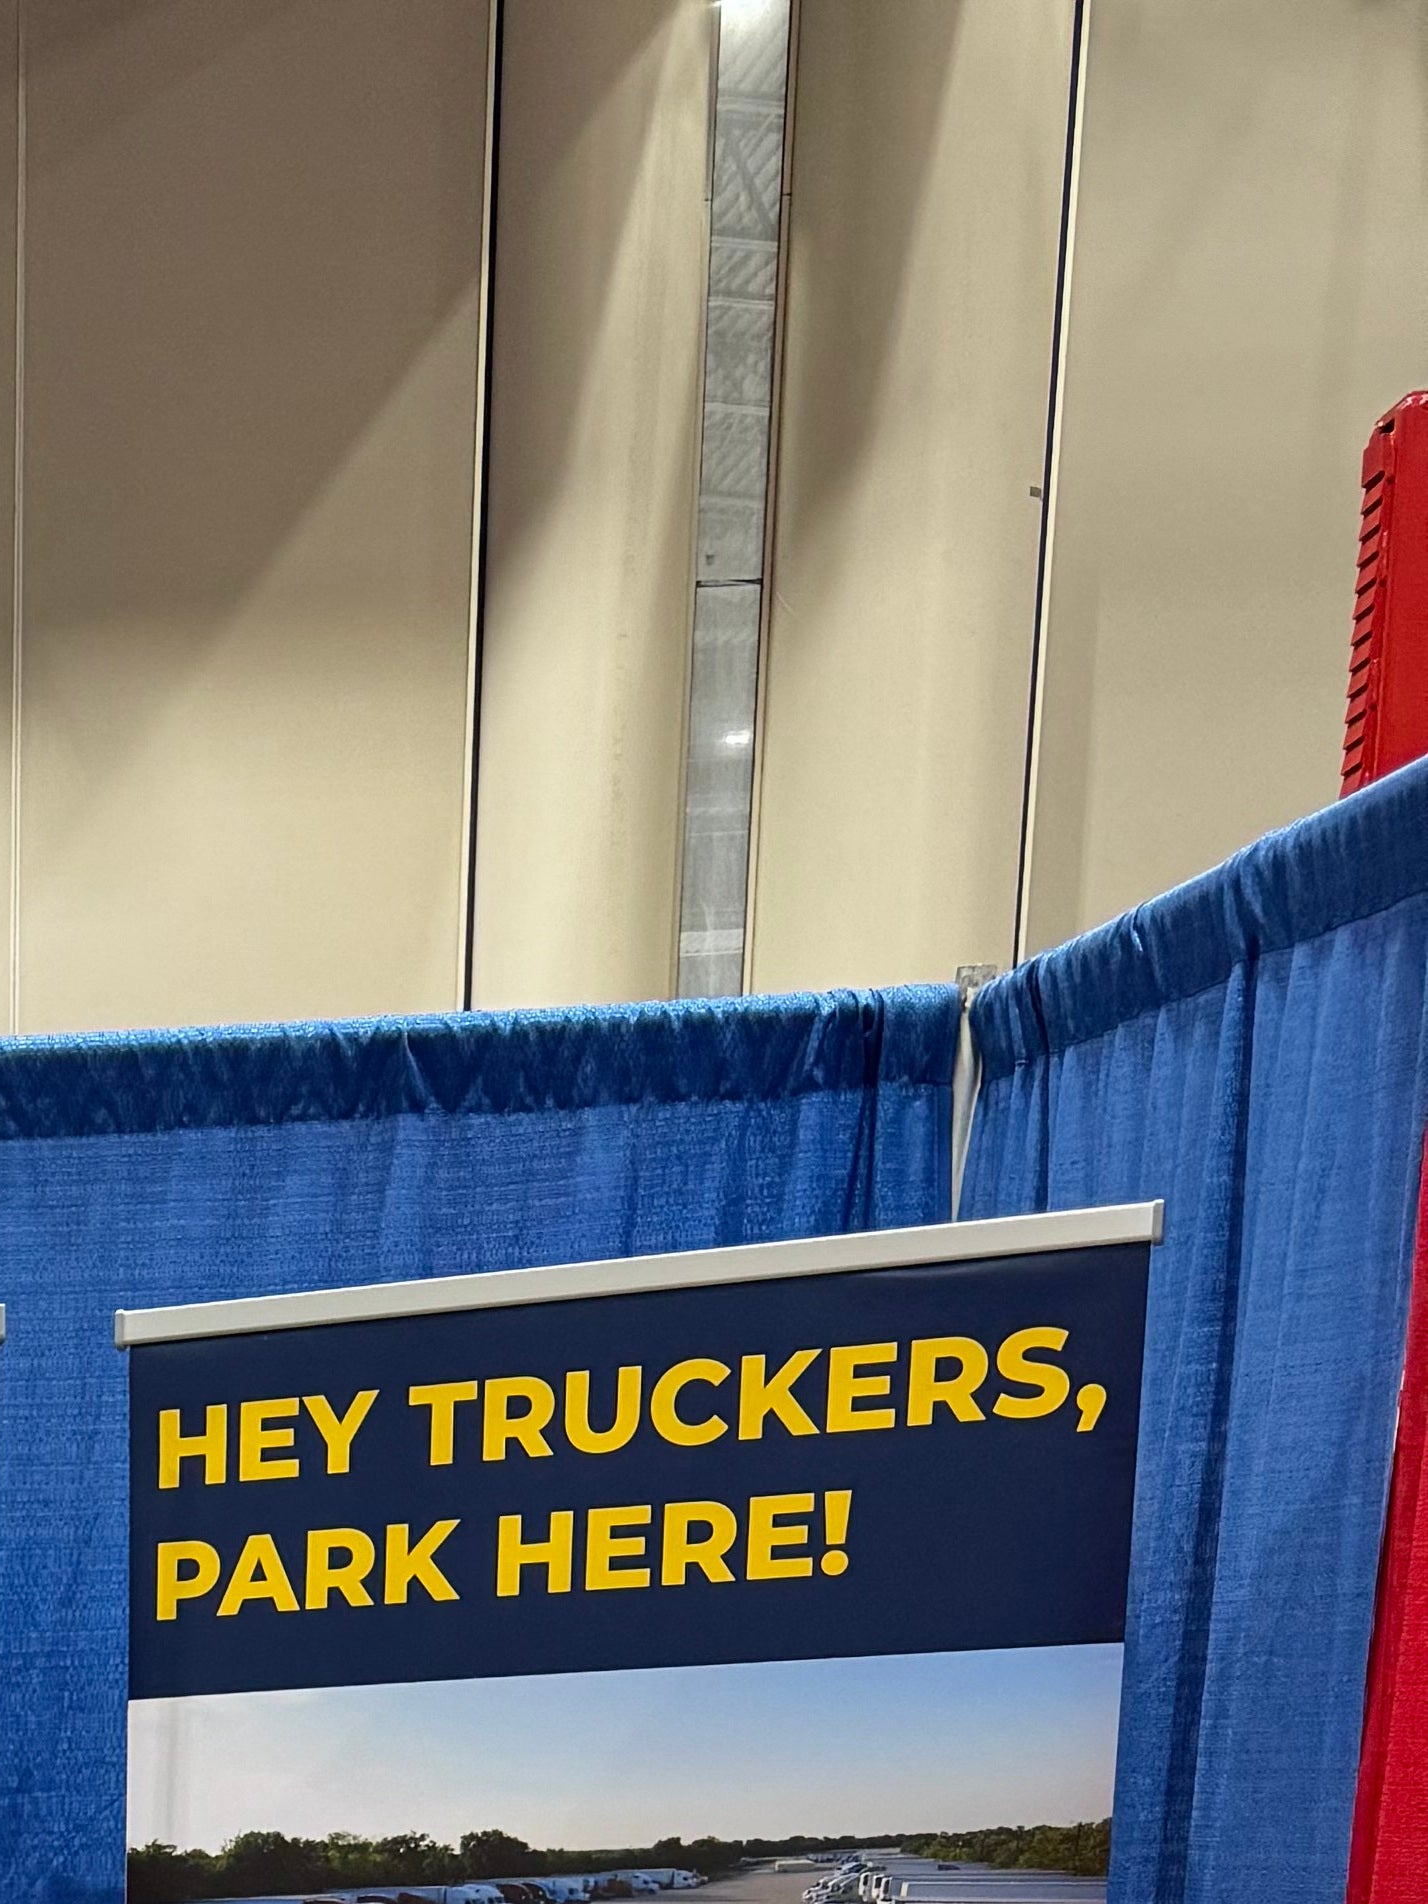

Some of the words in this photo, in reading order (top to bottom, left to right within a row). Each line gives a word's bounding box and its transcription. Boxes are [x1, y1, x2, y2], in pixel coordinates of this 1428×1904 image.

[159, 1392, 375, 1488] HEY
[409, 1328, 1105, 1465] TRUCKERS,
[157, 1522, 455, 1620] PARK
[497, 1492, 850, 1596] HERE!
